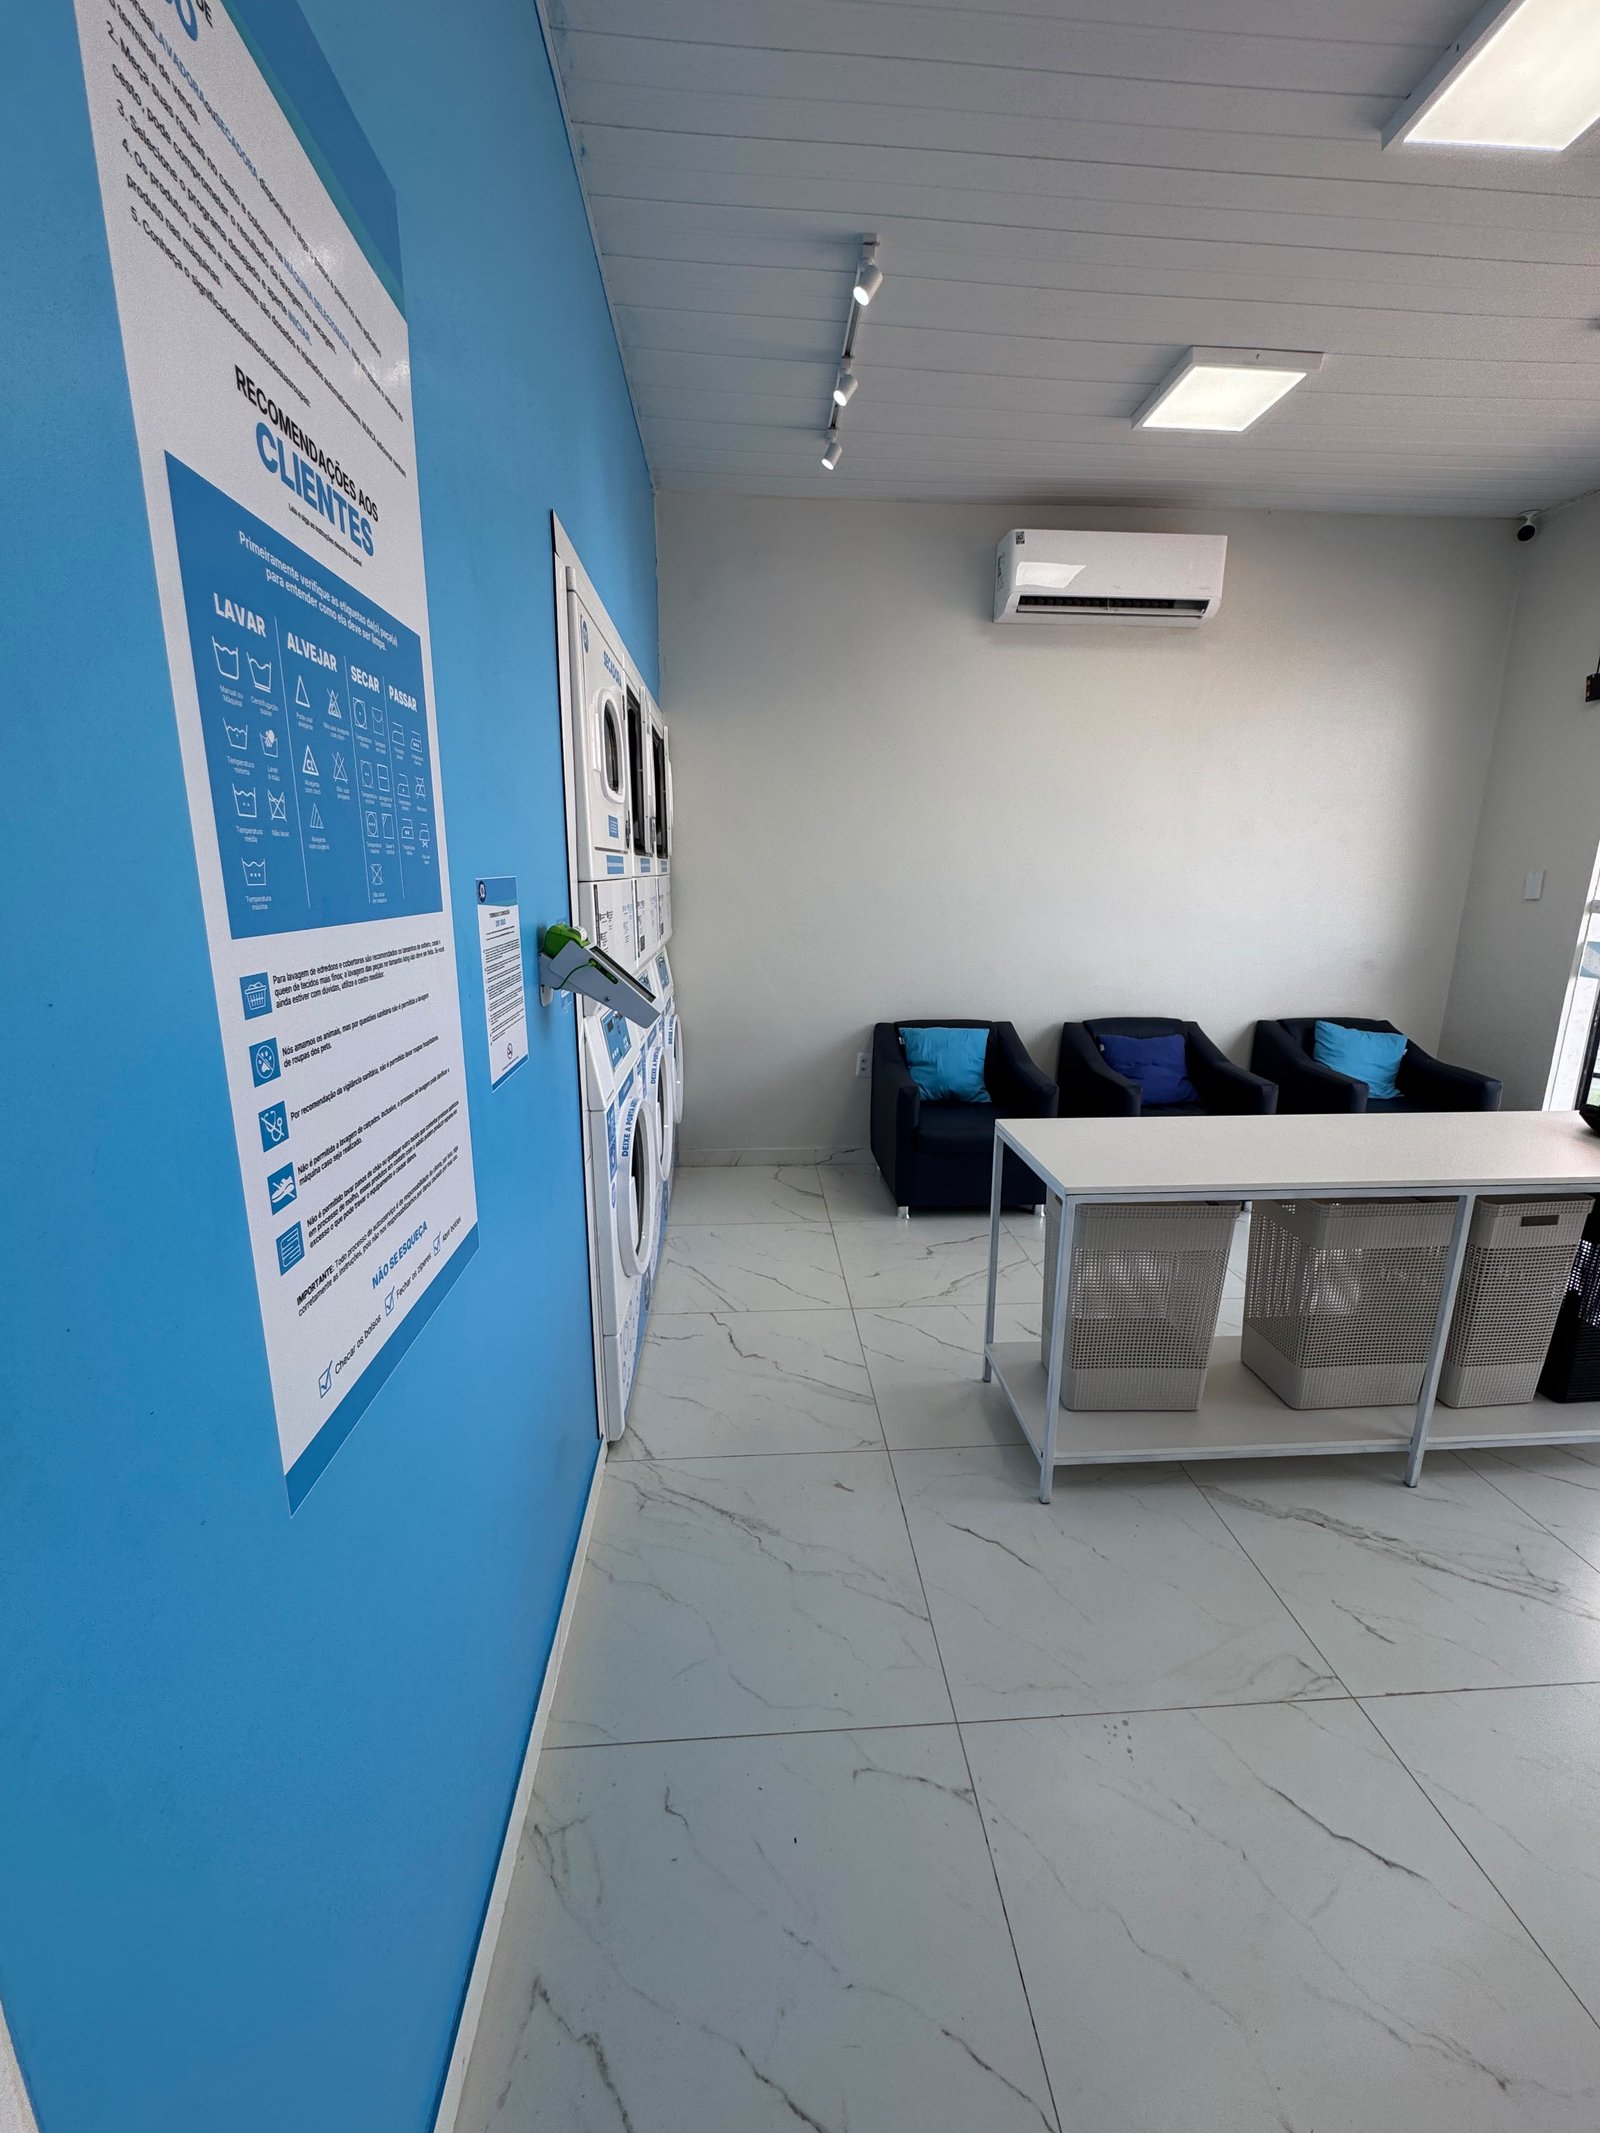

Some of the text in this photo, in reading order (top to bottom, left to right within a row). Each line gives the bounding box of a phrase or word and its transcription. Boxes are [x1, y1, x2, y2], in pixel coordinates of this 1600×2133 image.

[117, 4, 157, 67] terminal
[159, 64, 170, 85] de
[120, 37, 149, 87] Meça
[151, 83, 174, 118] suas
[175, 114, 206, 160] roupas
[207, 157, 218, 176] no
[219, 173, 240, 206] cesto
[134, 151, 148, 175] Os
[126, 174, 164, 222] produto
[165, 218, 181, 242] nas
[129, 115, 178, 182] Selecione
[187, 188, 227, 242] programa
[228, 238, 260, 282] desejado
[146, 107, 171, 145] pode
[173, 142, 228, 216] comprometer
[237, 222, 269, 268] resultado
[142, 219, 183, 271] Conheça
[235, 364, 378, 522] RECOMENDAÇÕES AOS
[256, 422, 374, 557] CLIENTES
[239, 530, 299, 581] Primeiramente
[300, 575, 330, 602] verifique
[339, 601, 366, 625] etiquetas
[214, 592, 266, 637] LAVAR
[266, 568, 284, 588] para
[285, 581, 318, 607] entender
[318, 602, 337, 620] como
[347, 619, 362, 636] deve
[287, 632, 337, 672] ALVEJAR
[351, 665, 380, 693] SECAR
[389, 685, 417, 712] PASSAR
[274, 986, 292, 998] queen
[286, 970, 309, 981] lavagem
[317, 963, 338, 974] edredons
[276, 997, 291, 1008] ainda
[292, 993, 309, 1004] estiver
[292, 1051, 310, 1064] roupas
[320, 1043, 332, 1054] pets.
[294, 1038, 316, 1052] amamos
[301, 1091, 336, 1114] recomendação
[297, 1163, 308, 1175] Não
[313, 1145, 335, 1165] permitida
[339, 1130, 357, 1146] lavagem
[621, 1132, 631, 1157] DEIXE
[627, 1106, 637, 1126] PORTA
[299, 1166, 321, 1186] máquina
[321, 1158, 332, 1170] caso
[322, 1194, 343, 1216] permitido
[343, 1185, 354, 1197] lavar
[310, 1227, 330, 1248] excesso
[372, 1263, 389, 1289] NÃO
[398, 1221, 427, 1259] ESQUEÇA
[297, 1265, 333, 1306] IMPORTANTE:
[335, 1253, 347, 1267] Todo
[347, 1234, 367, 1258] processo
[298, 1279, 332, 1316] corretamente
[335, 1345, 356, 1374] Checar
[364, 1314, 381, 1339] bolsos
[396, 1277, 411, 1299] Fechar
